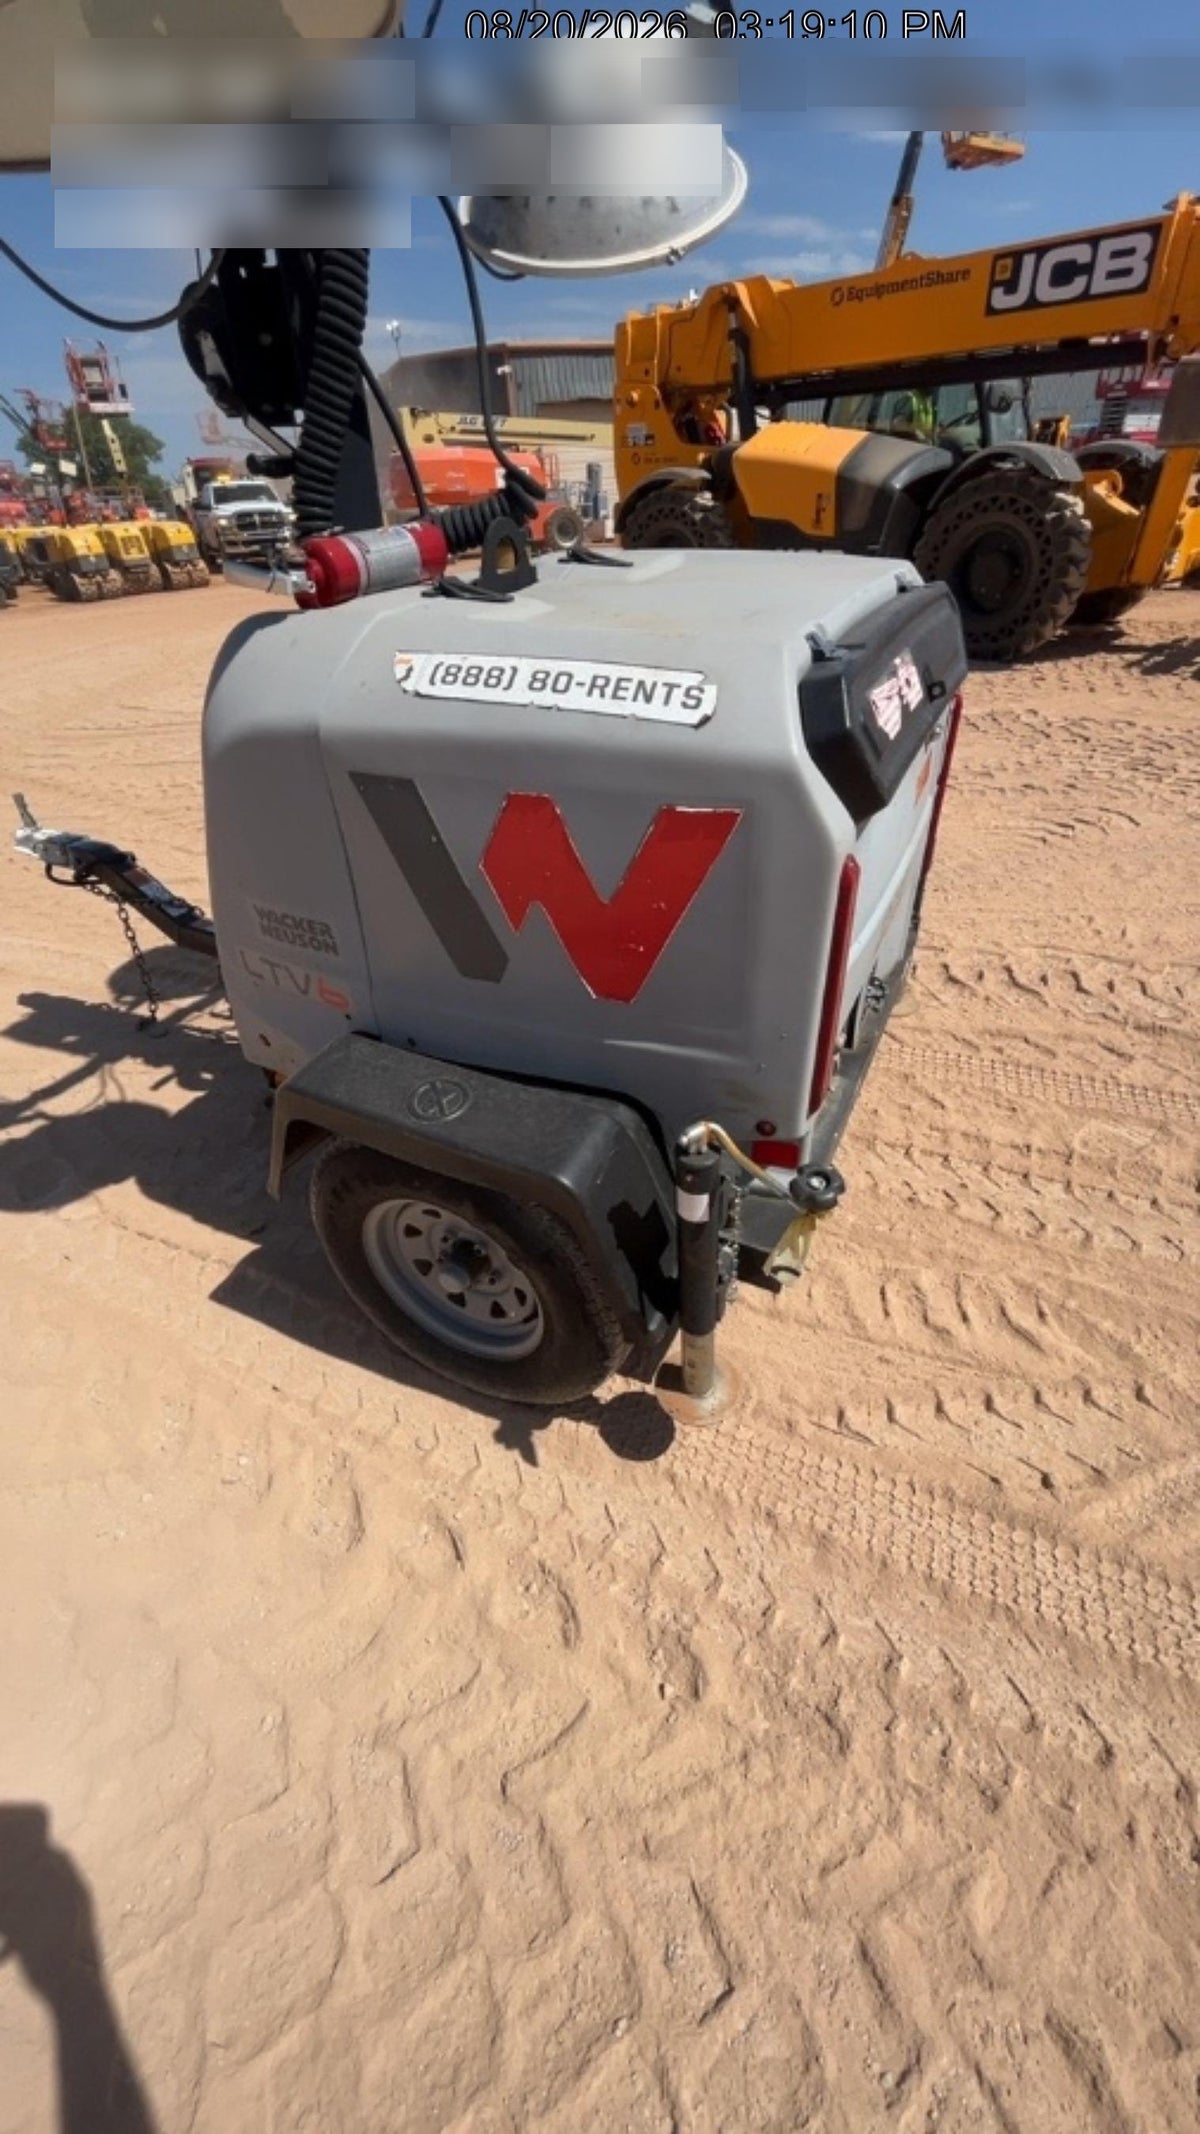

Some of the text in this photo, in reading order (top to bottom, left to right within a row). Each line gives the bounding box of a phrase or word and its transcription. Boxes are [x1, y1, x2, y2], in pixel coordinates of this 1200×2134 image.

[846, 267, 972, 303] EquipmentShare
[990, 231, 1154, 310] JCB
[428, 661, 705, 710] (888) 80-RENTS
[253, 904, 334, 939] WACKER
[259, 924, 339, 957] NEUSON
[239, 949, 351, 1012] LTV6
